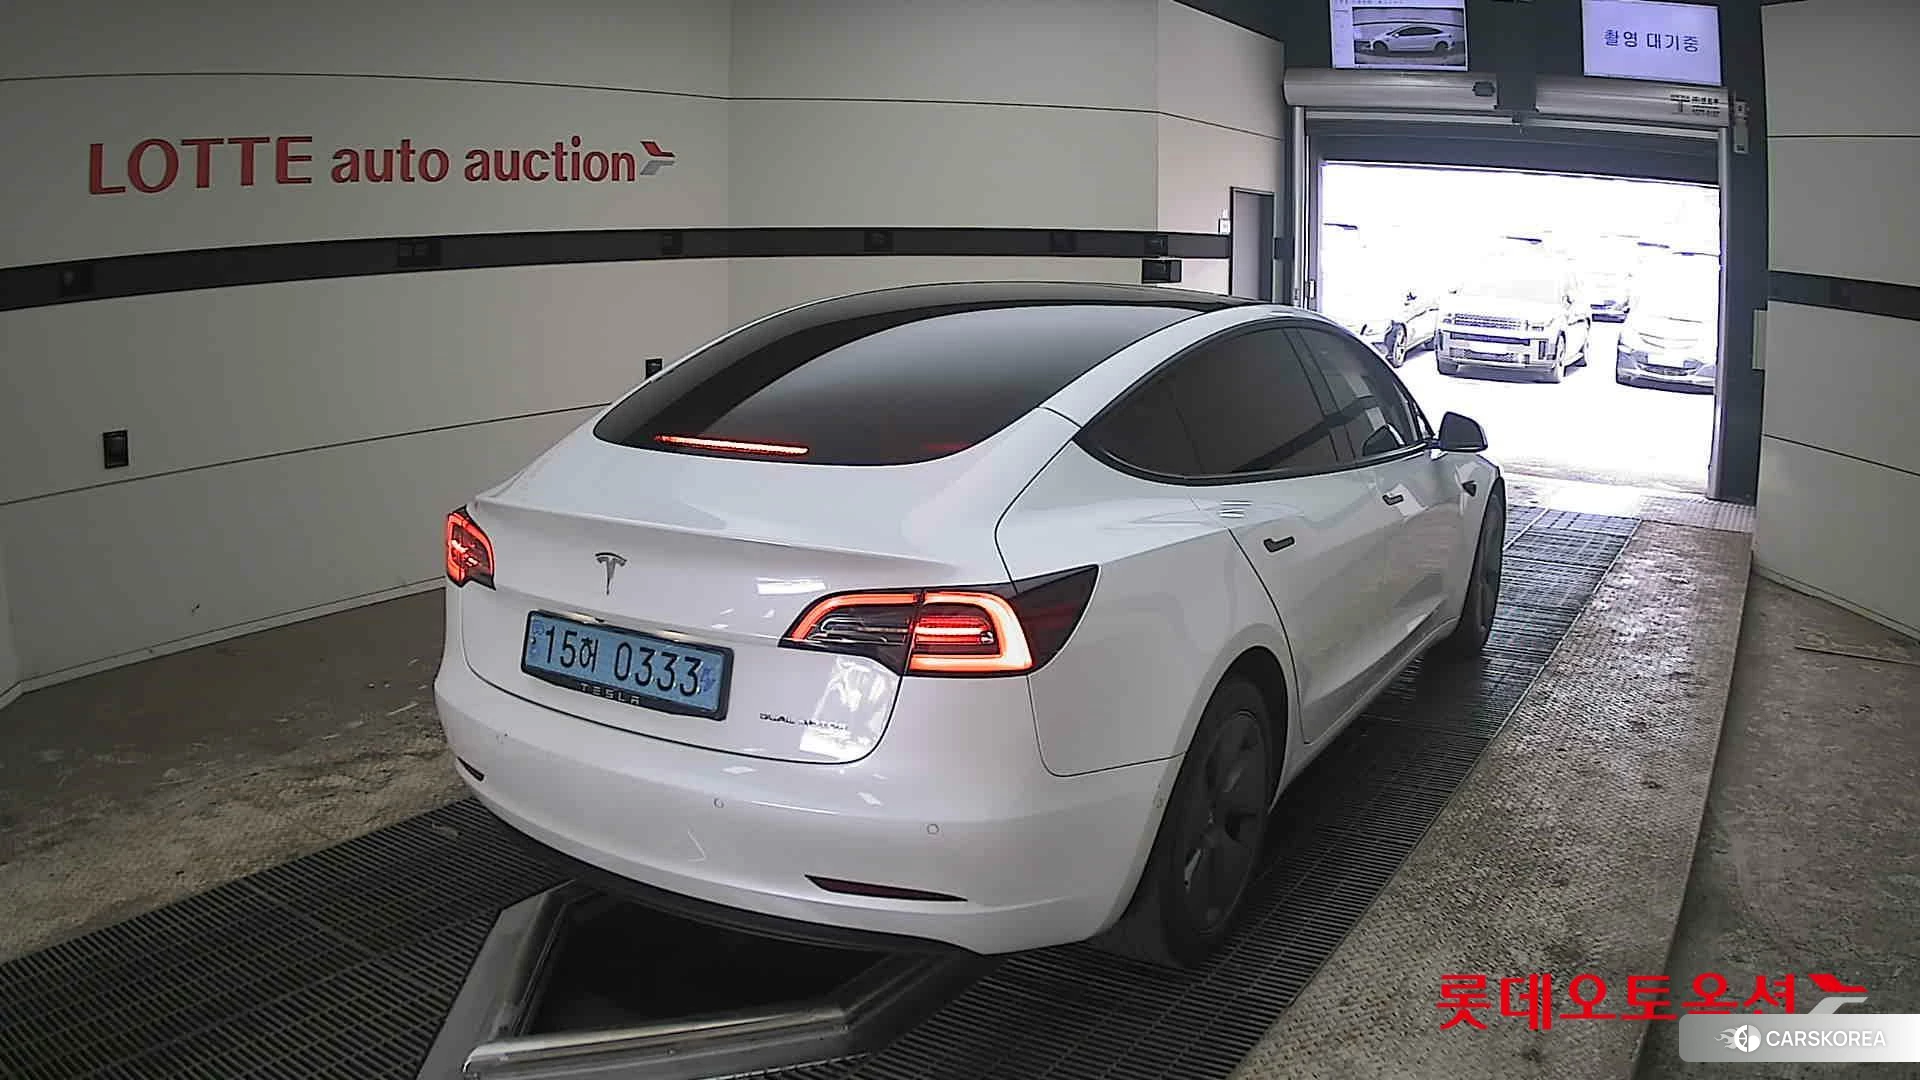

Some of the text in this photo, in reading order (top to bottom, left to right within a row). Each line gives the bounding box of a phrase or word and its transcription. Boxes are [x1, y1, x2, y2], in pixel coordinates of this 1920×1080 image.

[1605, 29, 1699, 52] 촬영 대기중
[89, 135, 636, 195] LOTTE auto auction
[545, 625, 702, 697] 15허 0333
[580, 682, 641, 705] TESLA
